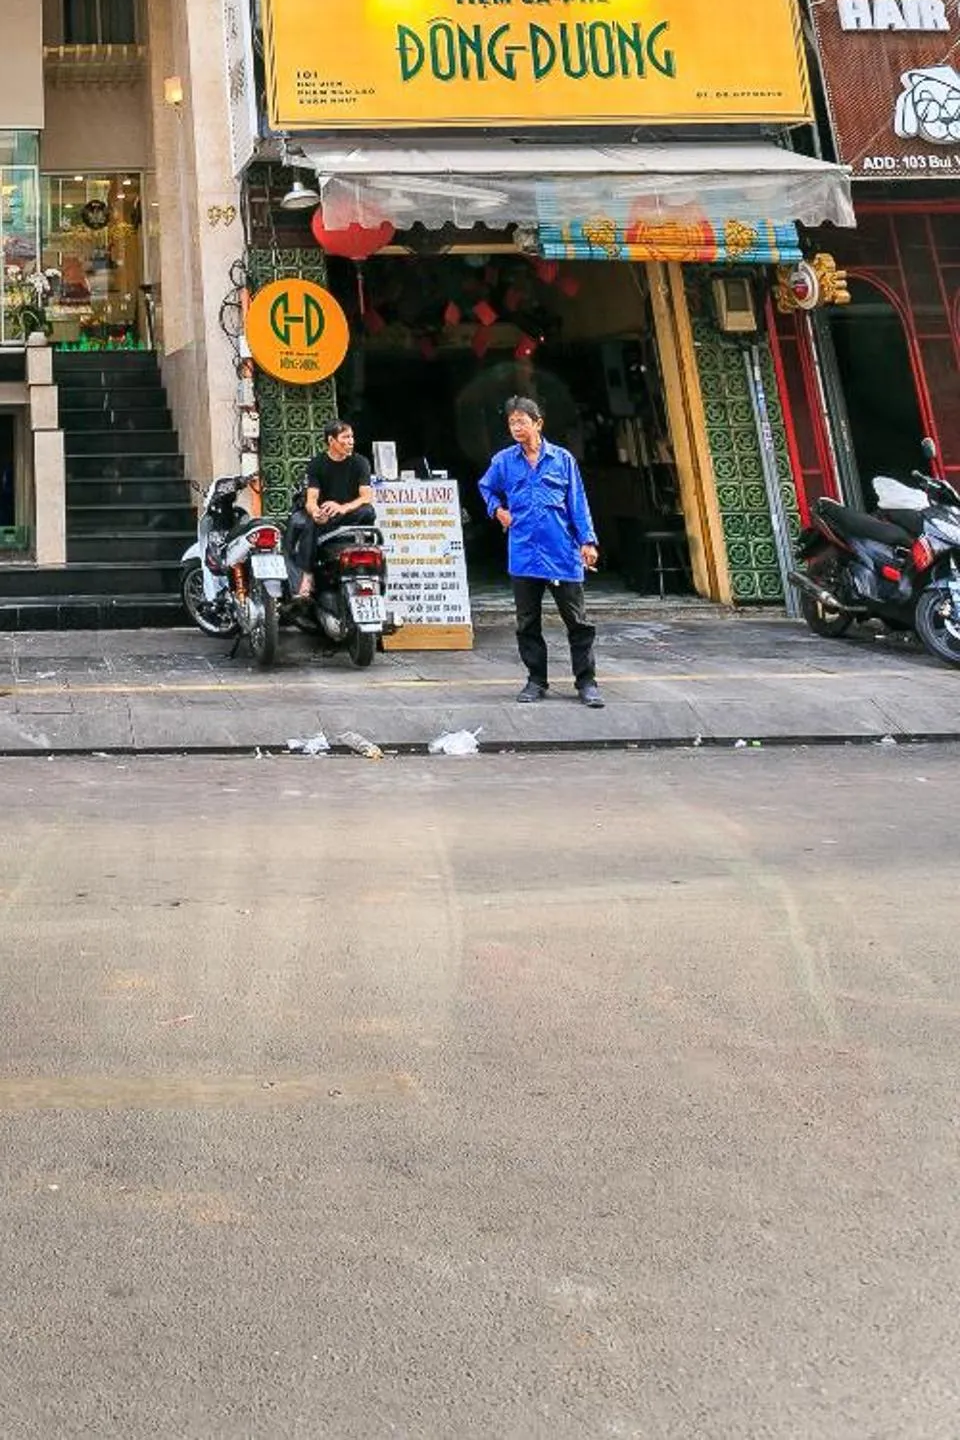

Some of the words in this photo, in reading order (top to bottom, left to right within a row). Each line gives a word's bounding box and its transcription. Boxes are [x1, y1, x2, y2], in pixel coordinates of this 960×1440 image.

[863, 156, 901, 170] ADD:
[902, 155, 926, 169] 103
[207, 205, 237, 228] 99
